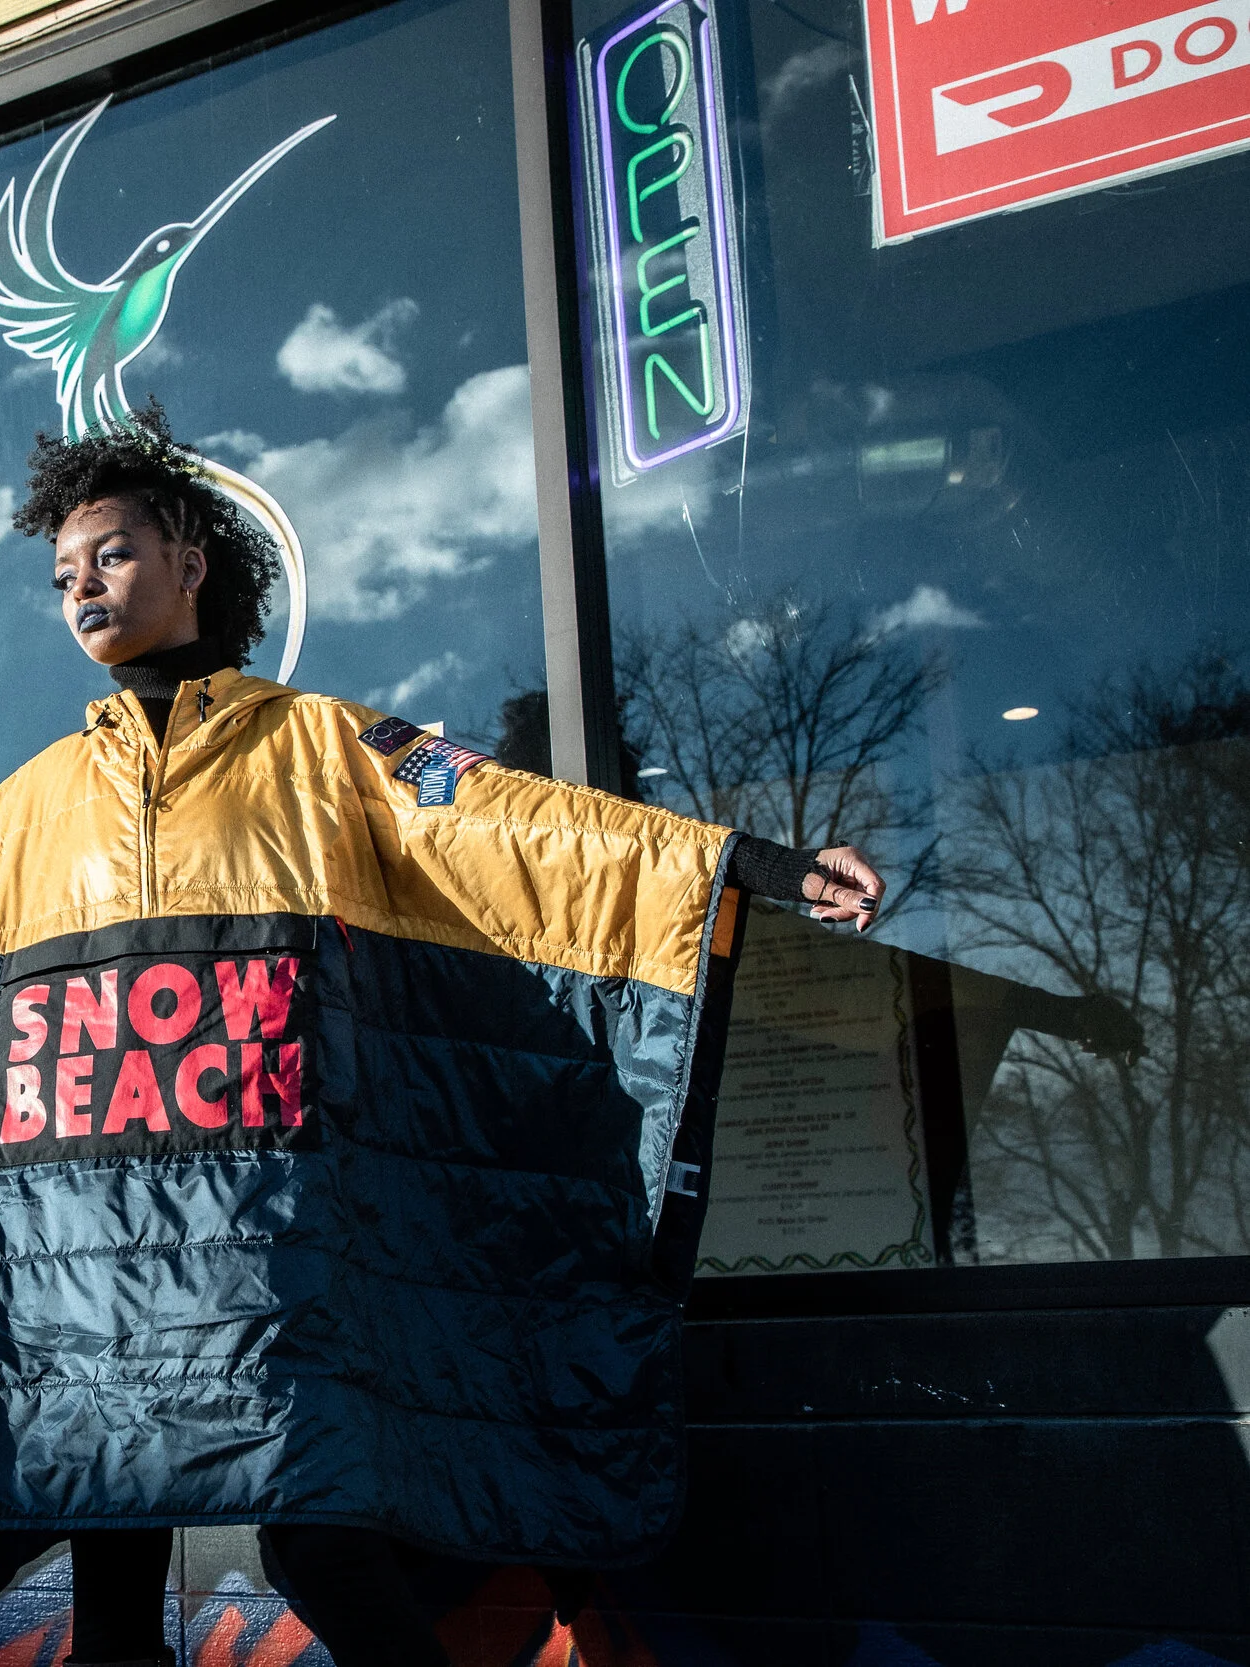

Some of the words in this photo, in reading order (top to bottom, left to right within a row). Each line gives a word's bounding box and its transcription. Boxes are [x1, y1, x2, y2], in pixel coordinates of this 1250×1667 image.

[1111, 16, 1250, 90] DO
[617, 31, 714, 440] OPEN
[362, 718, 409, 746] POLO
[420, 769, 449, 804] SNOW
[9, 957, 300, 1063] SNOW
[0, 1042, 303, 1145] BEACH
